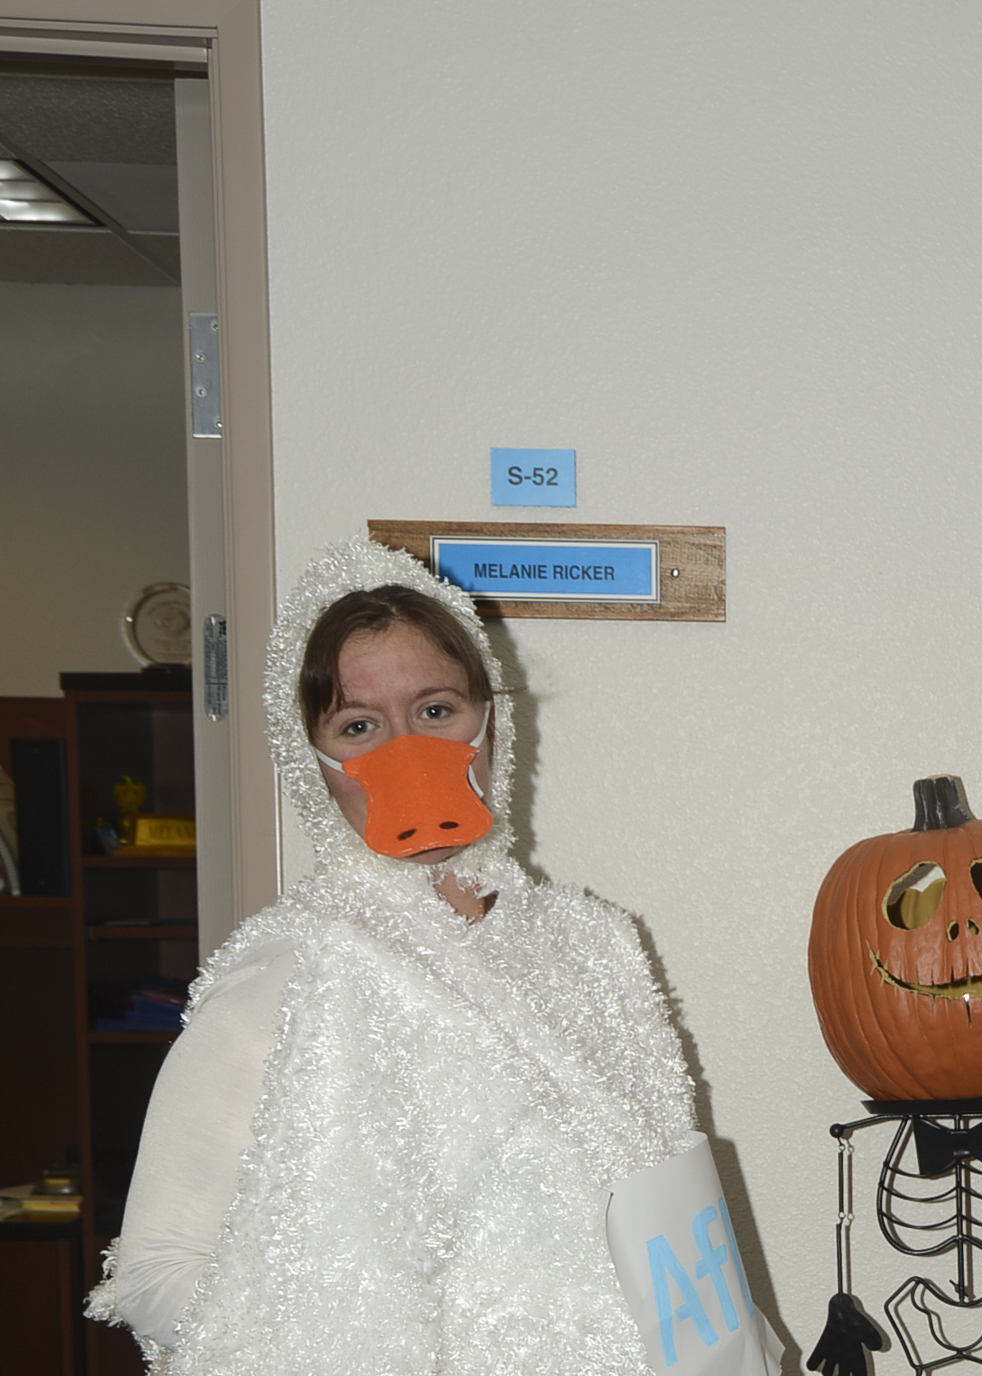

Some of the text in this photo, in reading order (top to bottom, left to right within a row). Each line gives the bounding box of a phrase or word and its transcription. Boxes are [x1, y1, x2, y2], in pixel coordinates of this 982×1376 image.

[507, 466, 559, 486] S-52
[474, 563, 616, 581] MELANIE RICKER
